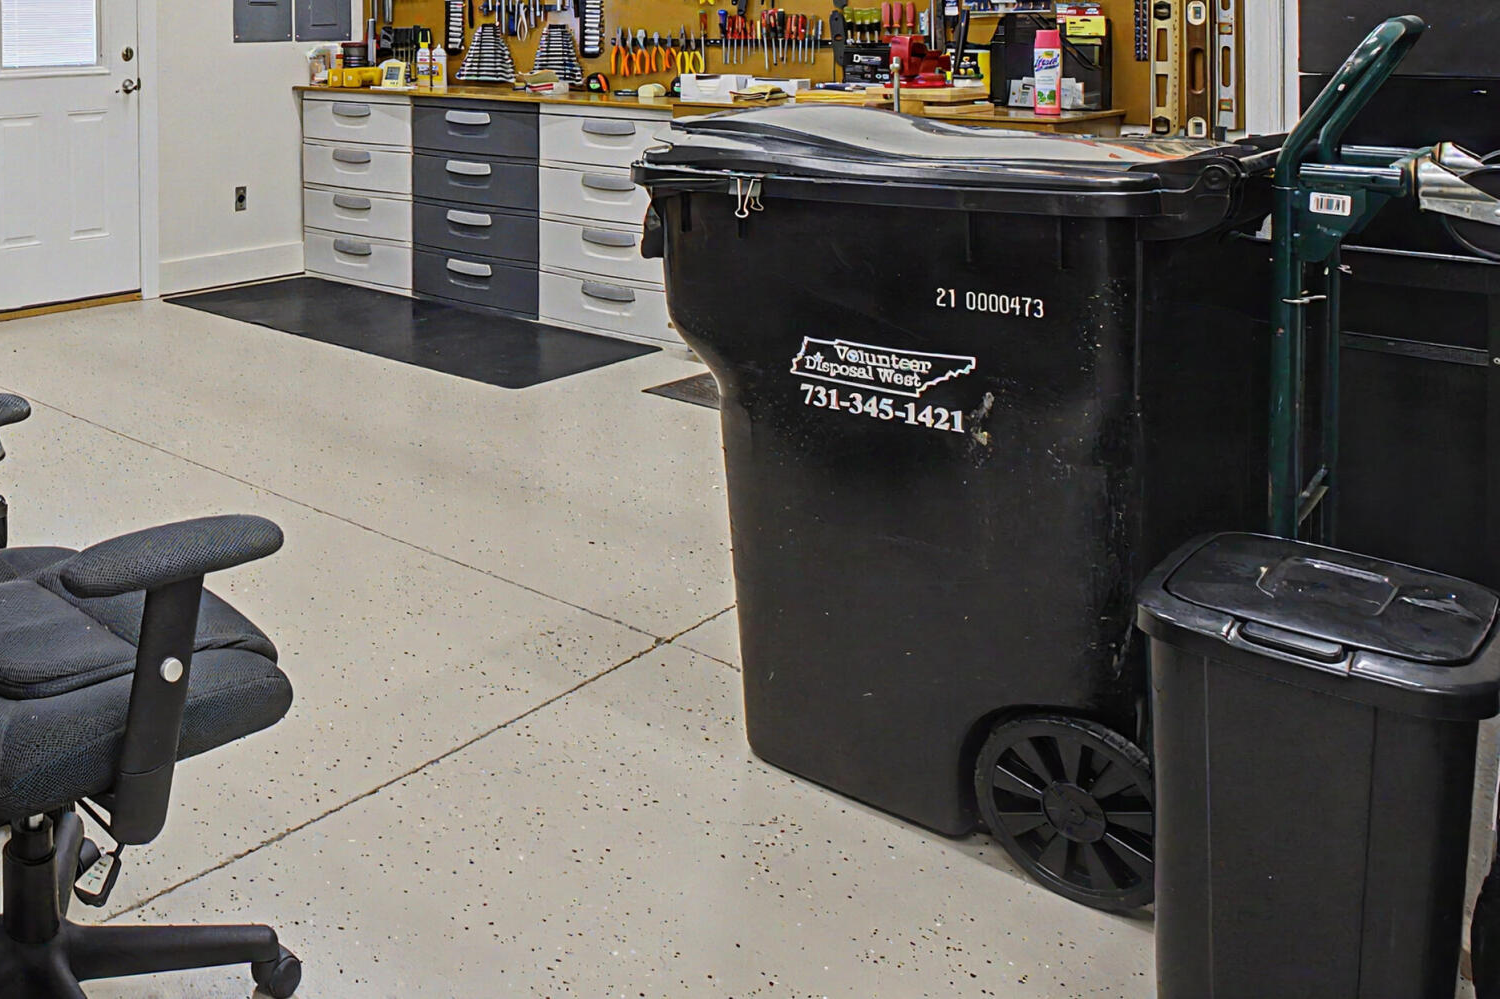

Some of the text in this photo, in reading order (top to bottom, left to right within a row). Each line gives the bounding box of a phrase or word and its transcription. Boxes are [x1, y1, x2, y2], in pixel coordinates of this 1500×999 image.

[936, 287, 1044, 318] 21 0000473
[804, 352, 921, 387] Disposal West
[833, 344, 932, 374] Volunteer
[800, 383, 965, 433] 731-345-1421
